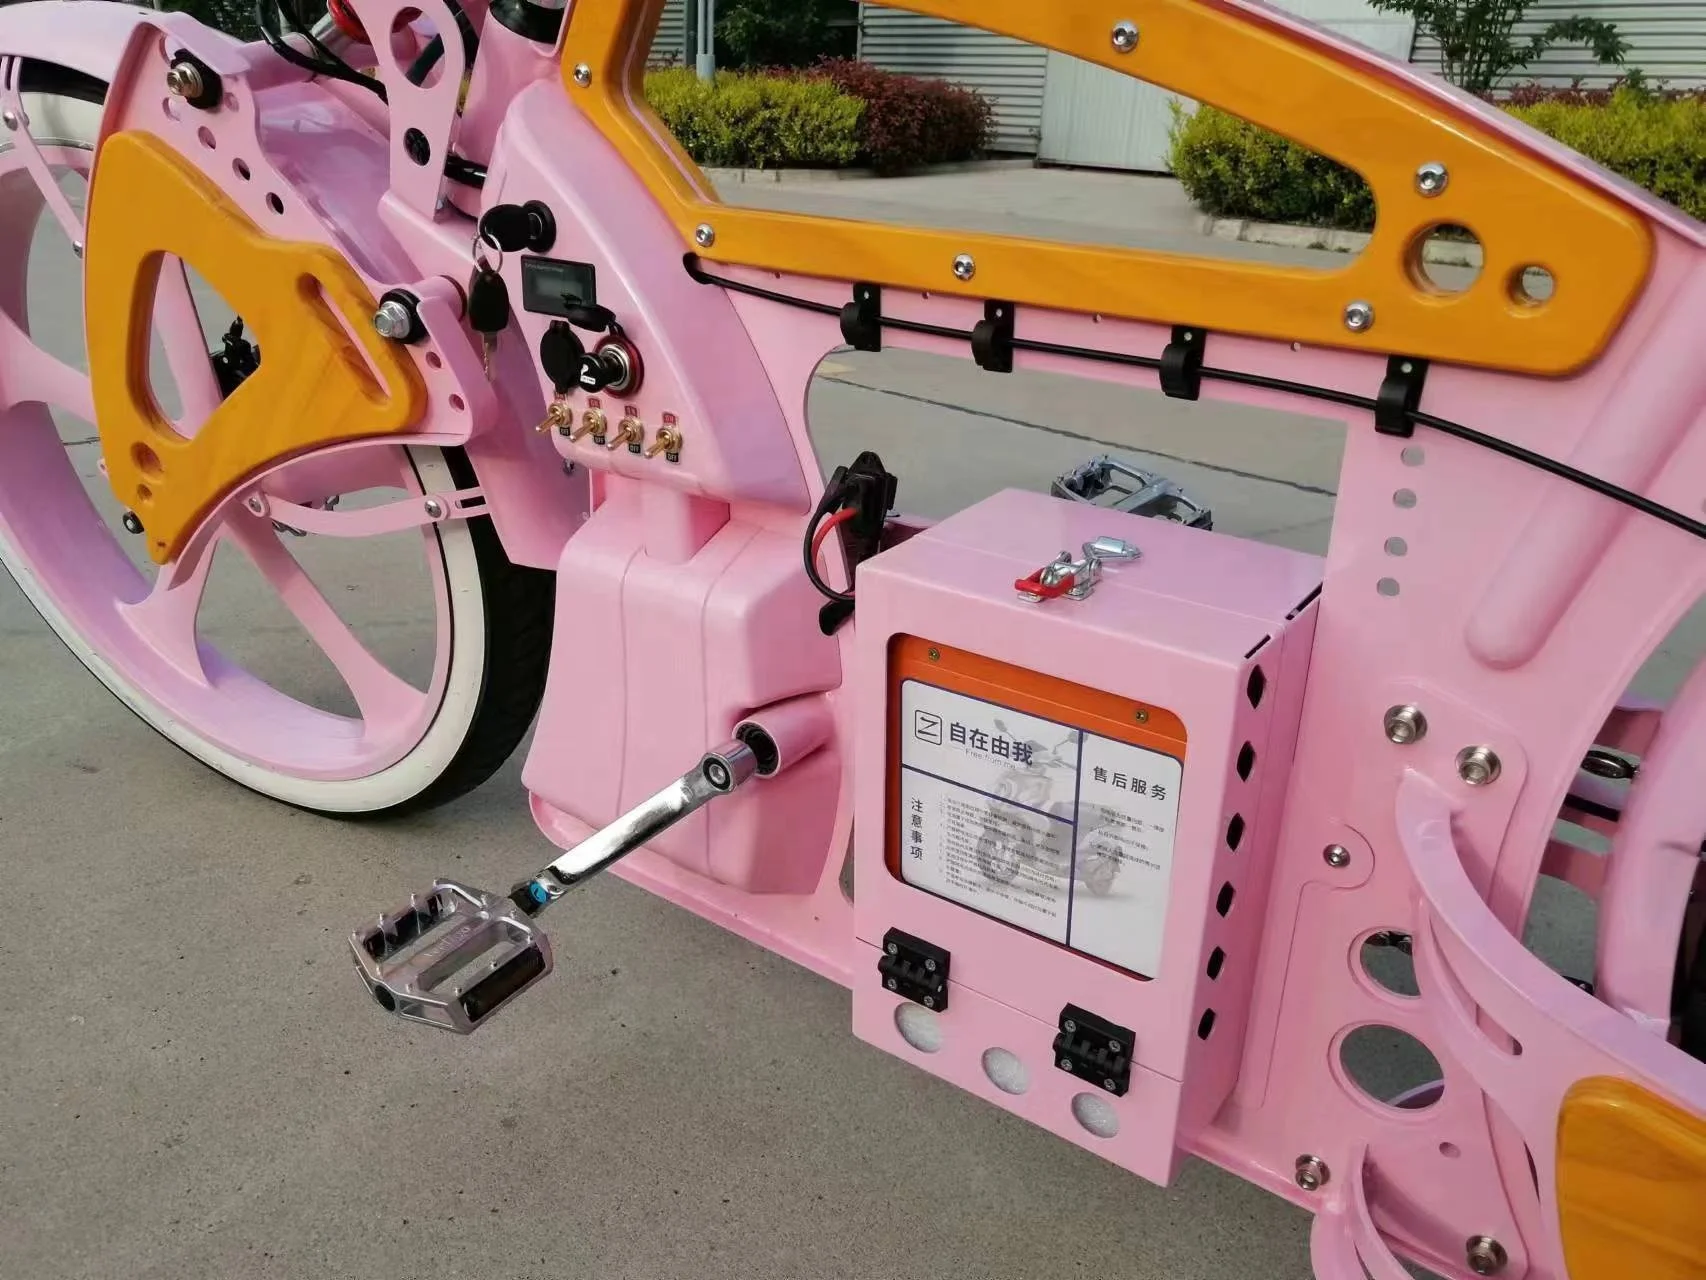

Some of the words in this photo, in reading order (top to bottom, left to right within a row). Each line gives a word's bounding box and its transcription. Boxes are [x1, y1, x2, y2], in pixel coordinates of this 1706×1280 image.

[950, 722, 1032, 766] 自在由我
[1093, 766, 1167, 801] 售后服务
[910, 797, 923, 860] 注意事项
